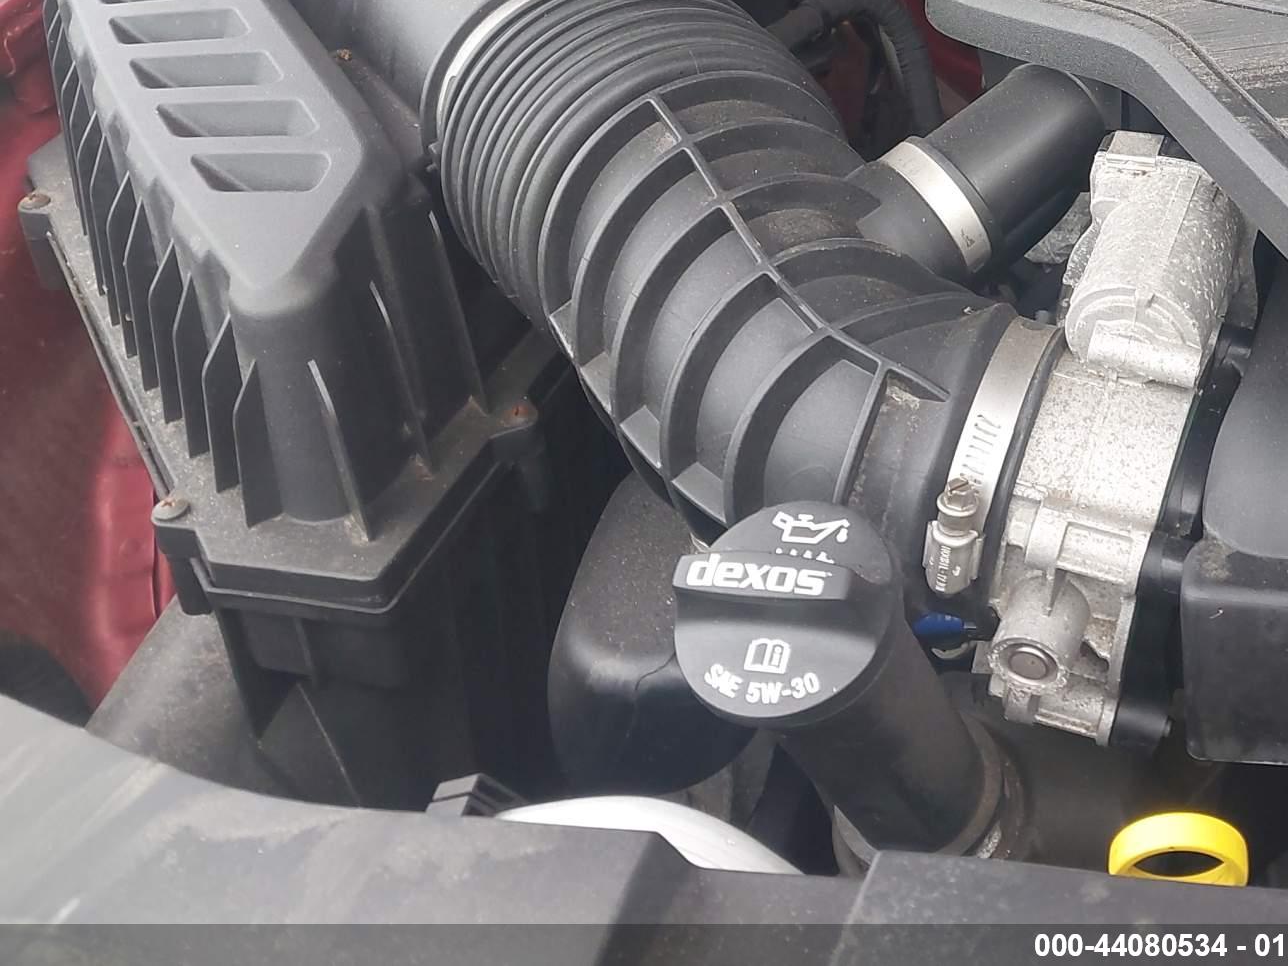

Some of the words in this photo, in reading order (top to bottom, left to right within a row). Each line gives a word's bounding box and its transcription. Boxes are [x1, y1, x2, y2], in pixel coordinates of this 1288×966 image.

[686, 553, 826, 596] dexos
[703, 663, 744, 699] SAE
[745, 672, 820, 704] 5W-30
